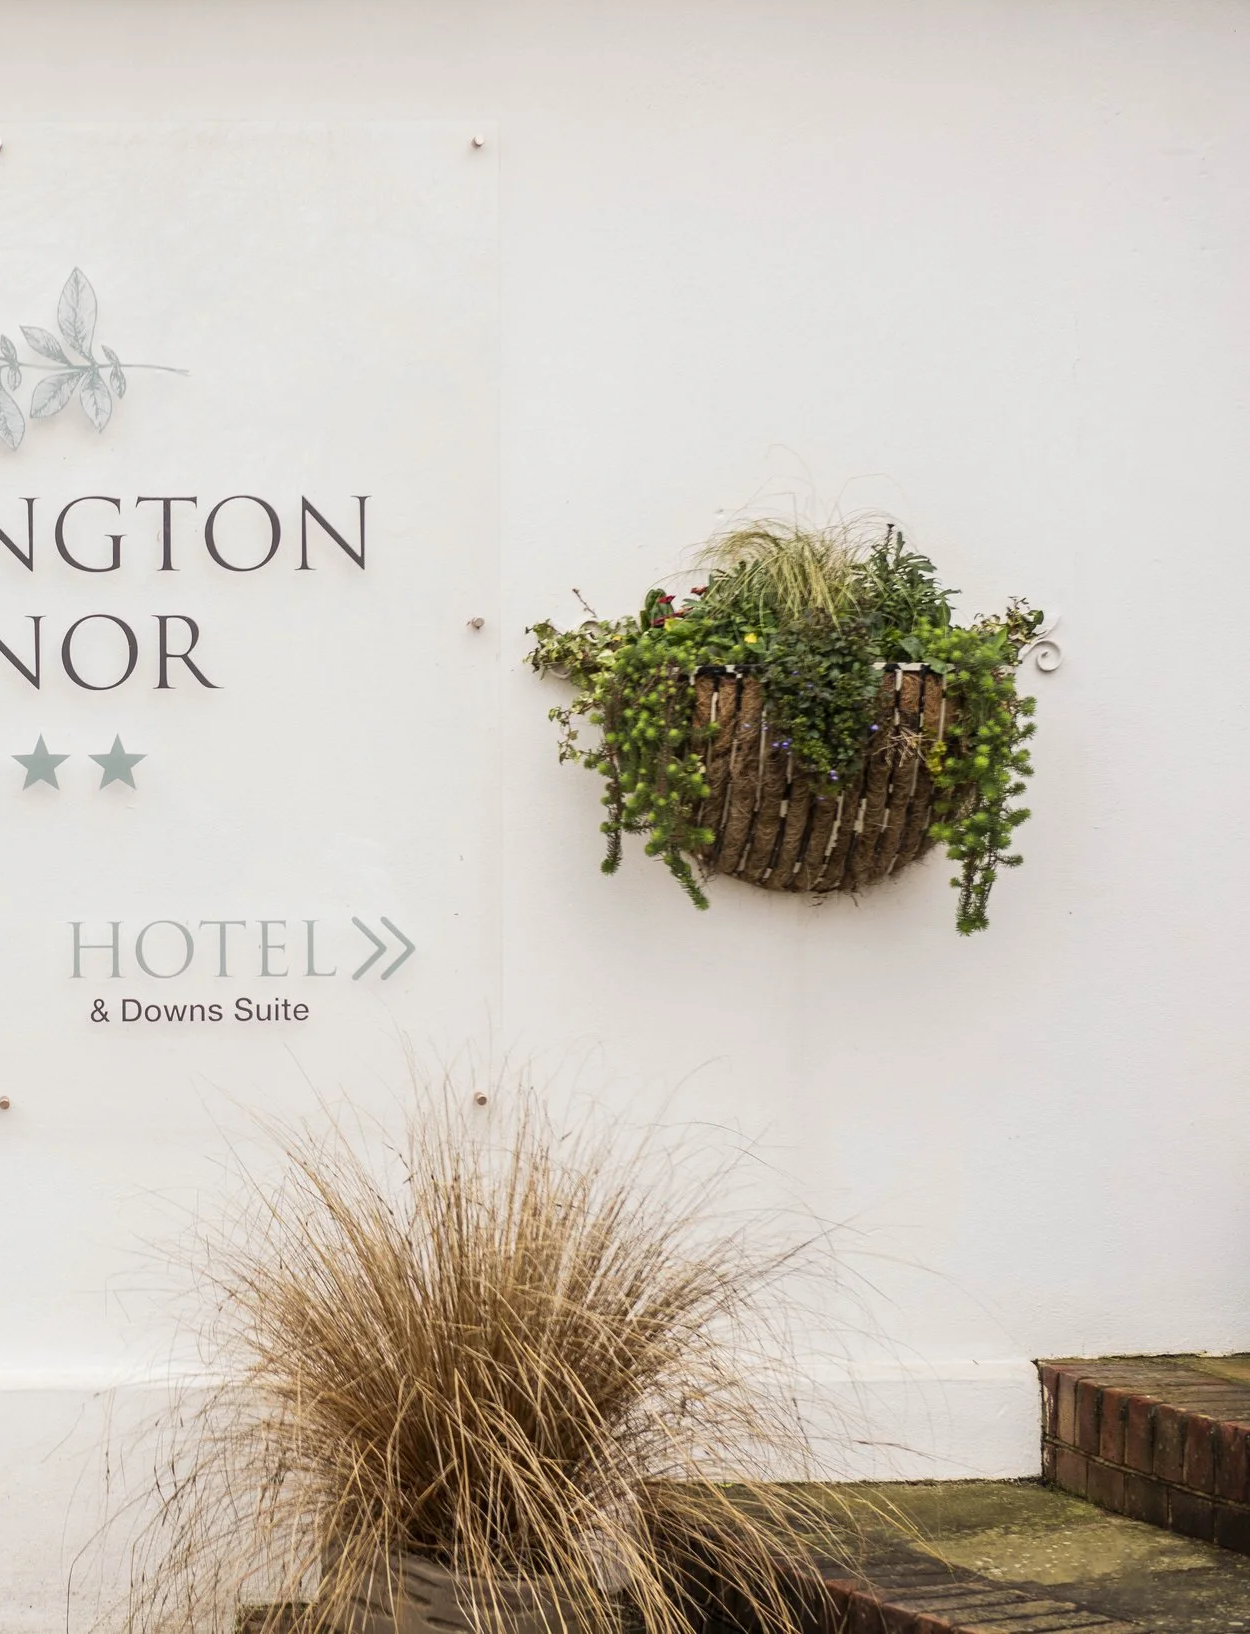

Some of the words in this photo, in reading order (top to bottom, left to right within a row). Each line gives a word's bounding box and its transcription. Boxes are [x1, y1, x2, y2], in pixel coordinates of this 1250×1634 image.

[69, 919, 337, 979] HOTEL
[90, 999, 110, 1023] &
[121, 998, 224, 1023] Downs
[234, 997, 310, 1022] Suite
